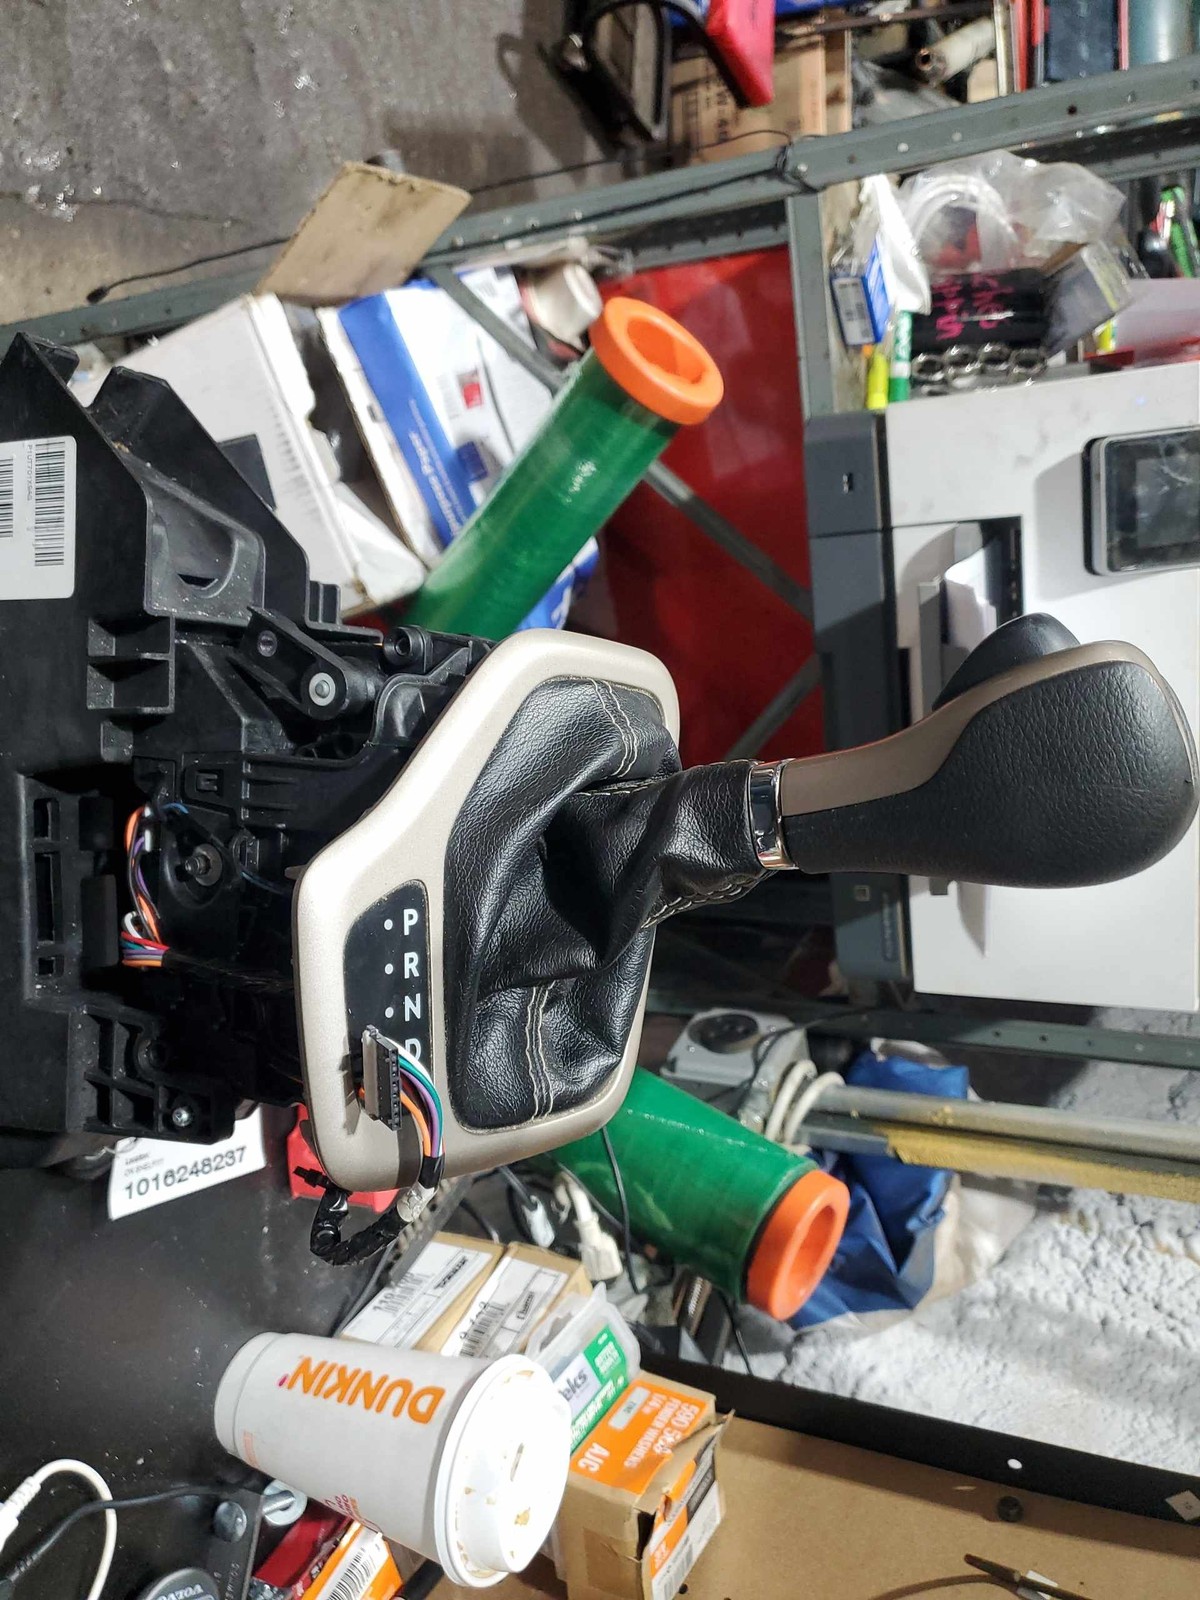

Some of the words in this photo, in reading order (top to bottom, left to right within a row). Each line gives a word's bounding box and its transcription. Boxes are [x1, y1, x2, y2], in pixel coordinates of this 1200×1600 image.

[403, 908, 419, 936] P
[404, 952, 420, 980] R
[404, 993, 421, 1022] N
[124, 1145, 247, 1200] 1016248237
[278, 1355, 446, 1425] DUNKIN'
